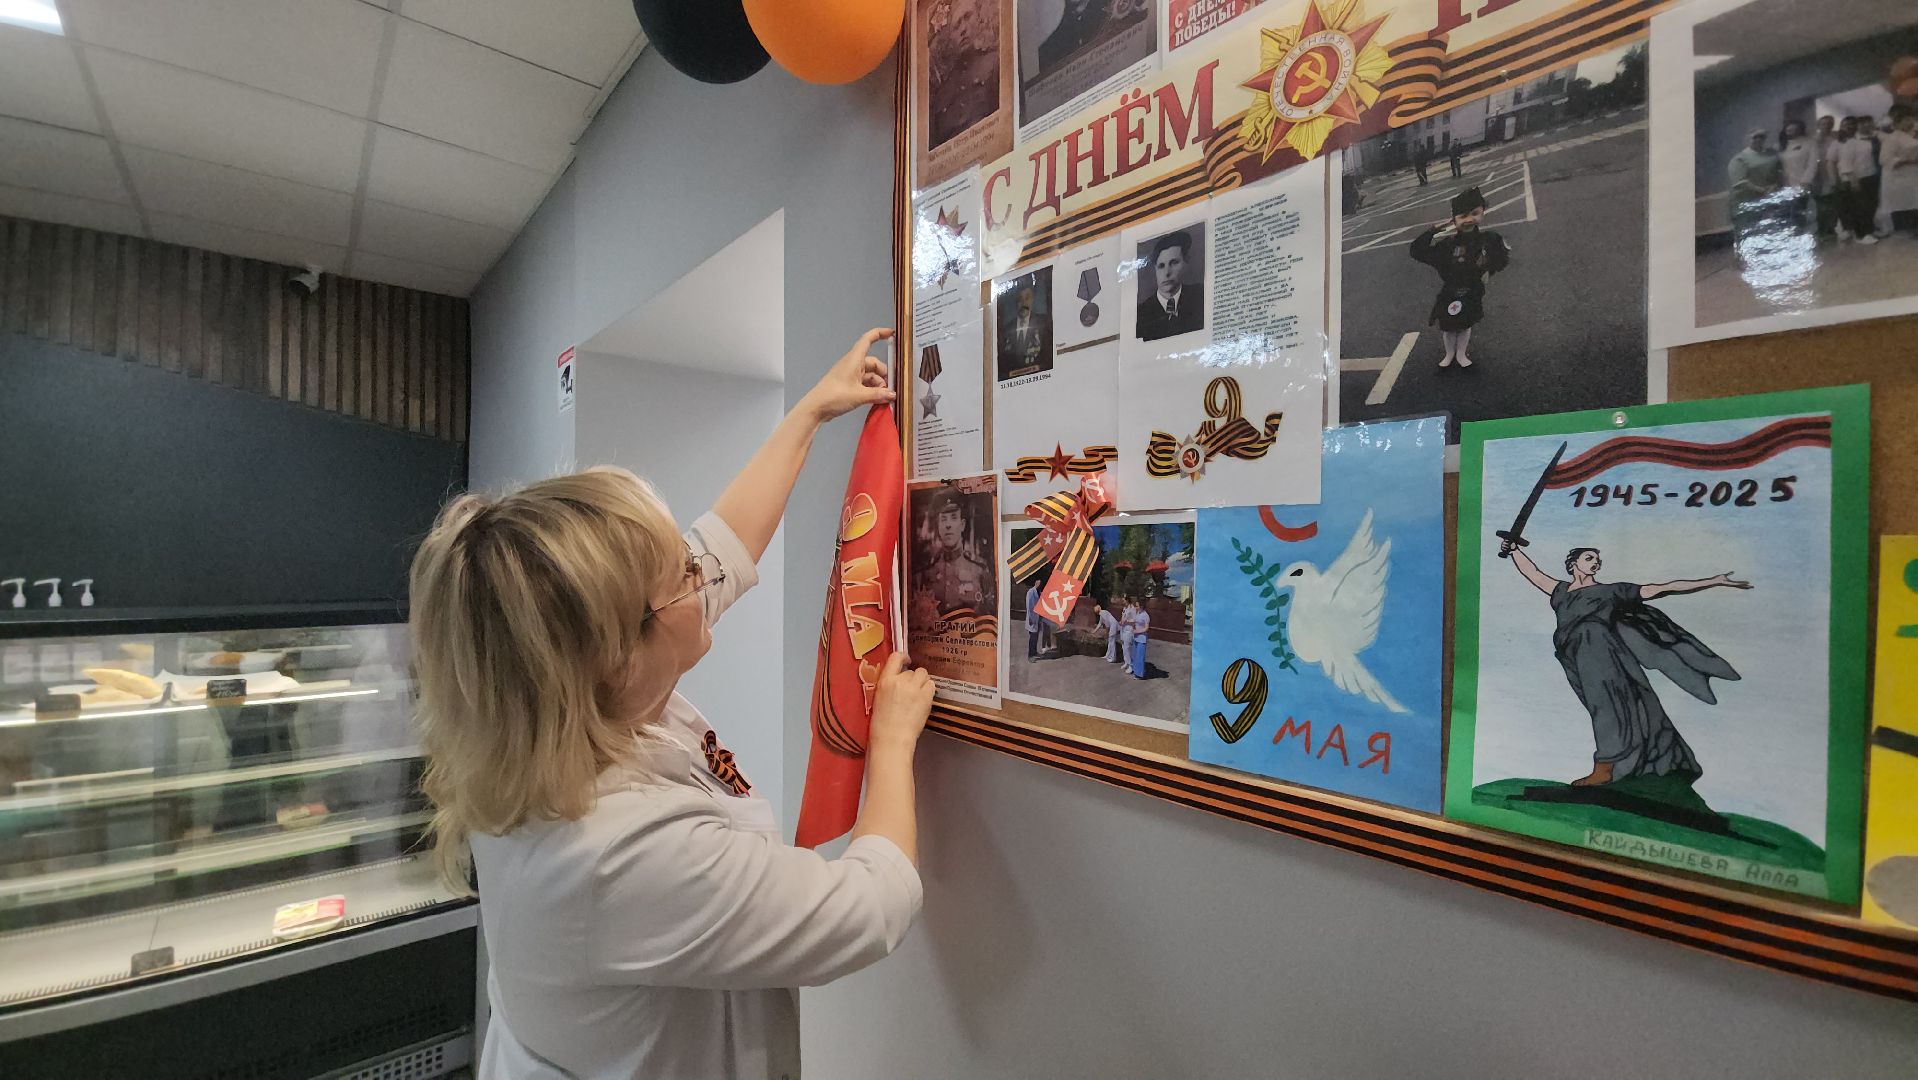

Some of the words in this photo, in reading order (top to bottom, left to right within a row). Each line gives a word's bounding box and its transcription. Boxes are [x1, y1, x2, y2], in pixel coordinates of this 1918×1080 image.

[1175, 12, 1184, 29] С
[1175, 1, 1236, 46] ПОБЕДЫ!
[983, 167, 1012, 231] С
[1022, 59, 1221, 231] ДНЁМ
[1272, 716, 1391, 775] МАЯ
[1588, 829, 1729, 872] КАЙДЫШЕВА
